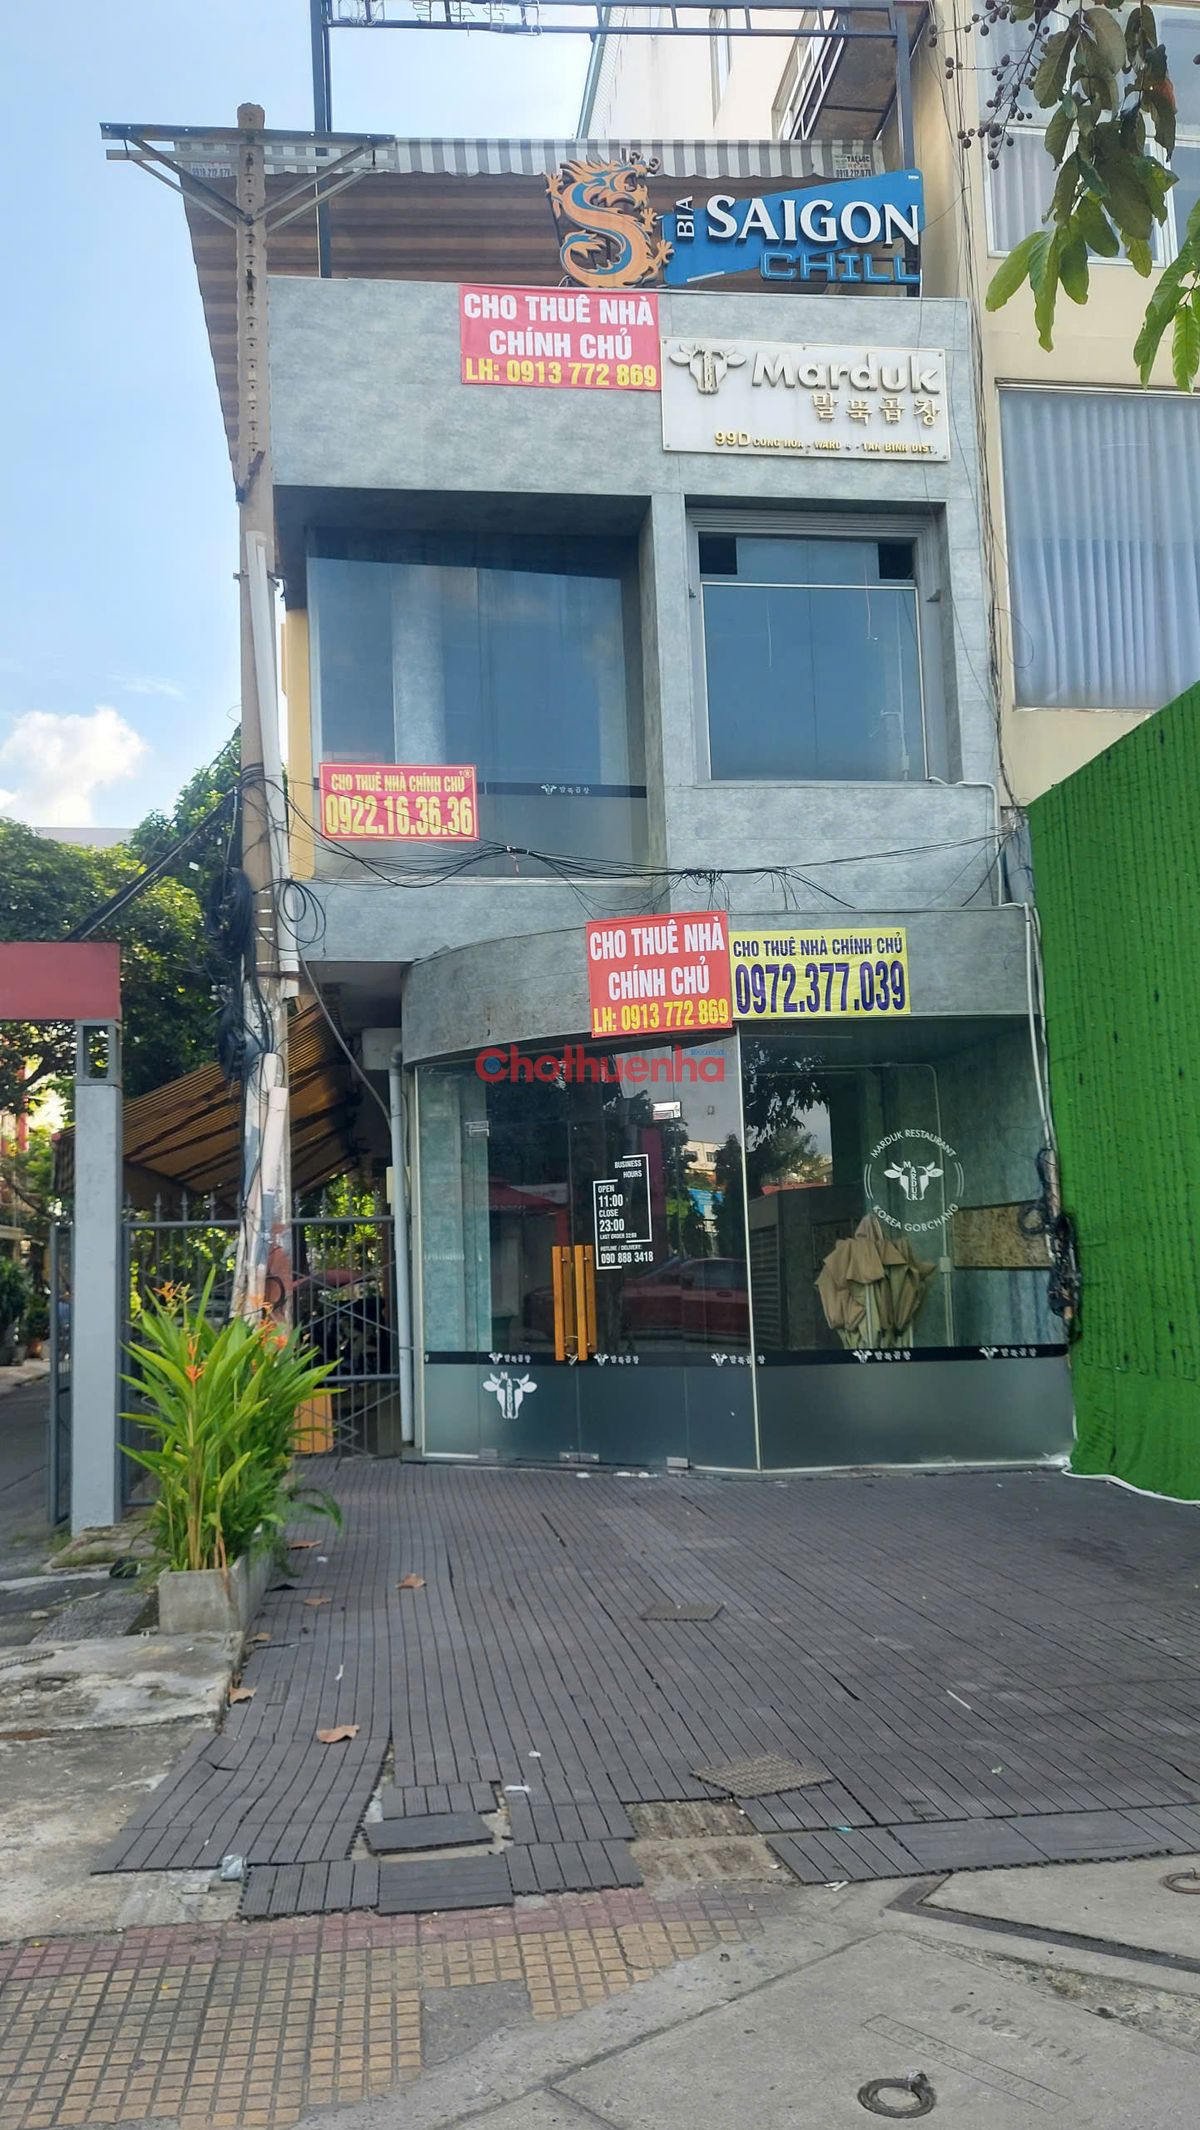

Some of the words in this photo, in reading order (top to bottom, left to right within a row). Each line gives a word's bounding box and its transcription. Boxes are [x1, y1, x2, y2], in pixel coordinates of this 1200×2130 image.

[676, 195, 695, 238] BIA
[706, 194, 919, 246] SAIGON
[760, 251, 921, 282] CHILL
[464, 293, 516, 320] CHO
[525, 295, 590, 324] THUÊ
[600, 295, 655, 326] NHÀ
[489, 327, 571, 359] CHÍNH
[580, 328, 632, 359] CHỦ
[466, 358, 500, 382] LH:
[507, 360, 562, 385] 0913
[568, 362, 610, 386] 772
[616, 363, 657, 388] 869
[752, 352, 940, 394] Marduk
[715, 431, 750, 447] 99D
[331, 774, 353, 791] CHO
[355, 771, 381, 791] THUÊ
[384, 770, 406, 791] NHÀ
[409, 772, 440, 792] CHÍNH
[325, 794, 473, 835] 0922.16.36.36
[590, 930, 627, 960] CHO
[631, 920, 679, 955] THUÊ
[684, 917, 725, 952] NHÀ
[733, 940, 759, 957] CHO
[764, 936, 797, 956] THUÊ
[800, 935, 828, 955] NHÀ
[832, 935, 873, 955] CHÍNH
[876, 932, 903, 953] CHỦ
[608, 965, 666, 1000] CHÍNH
[671, 955, 710, 994] CHỦ
[735, 961, 905, 1013] 0972.377.039
[593, 1007, 617, 1032] LH:
[621, 1003, 658, 1030] 0913
[663, 1002, 694, 1026] 772
[698, 999, 729, 1024] 869
[870, 1131, 904, 1159] MARDUK
[904, 1129, 957, 1157] RESTAURANT
[614, 1160, 642, 1169] BUSINESS
[623, 1170, 642, 1178] HOURS
[598, 1184, 615, 1193] OPEN
[903, 1161, 918, 1200] MARDUK
[598, 1194, 624, 1208] 11:00
[599, 1209, 619, 1217] CLOSE
[599, 1219, 625, 1232] 23:00
[872, 1204, 901, 1230] KOREA
[601, 1253, 615, 1264] 090
[618, 1252, 632, 1263] 888
[634, 1251, 654, 1262] 3418
